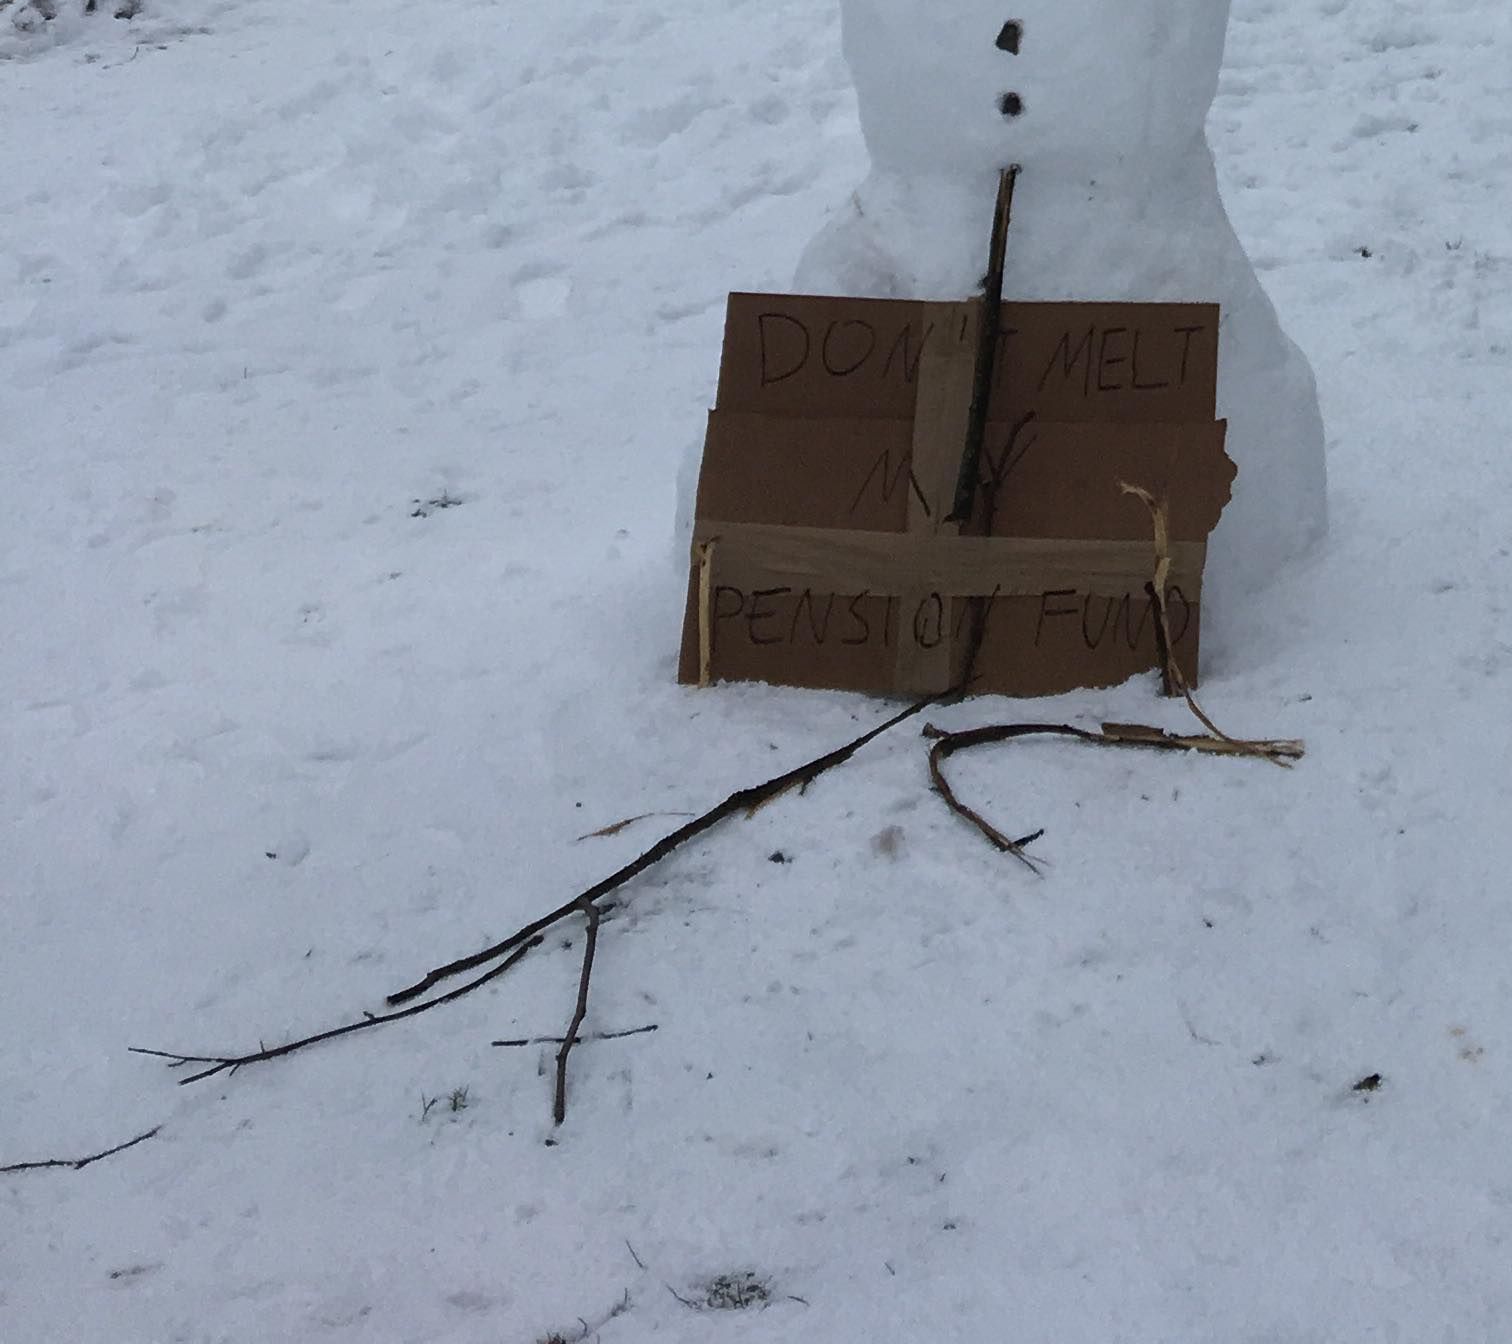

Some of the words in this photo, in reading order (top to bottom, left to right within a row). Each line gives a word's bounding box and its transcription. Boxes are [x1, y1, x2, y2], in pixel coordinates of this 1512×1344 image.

[757, 312, 1018, 387] DON'T
[1037, 324, 1205, 397] MELT
[850, 432, 1038, 518] MY
[709, 584, 1001, 652] PENSION
[1035, 586, 1190, 650] FUND
